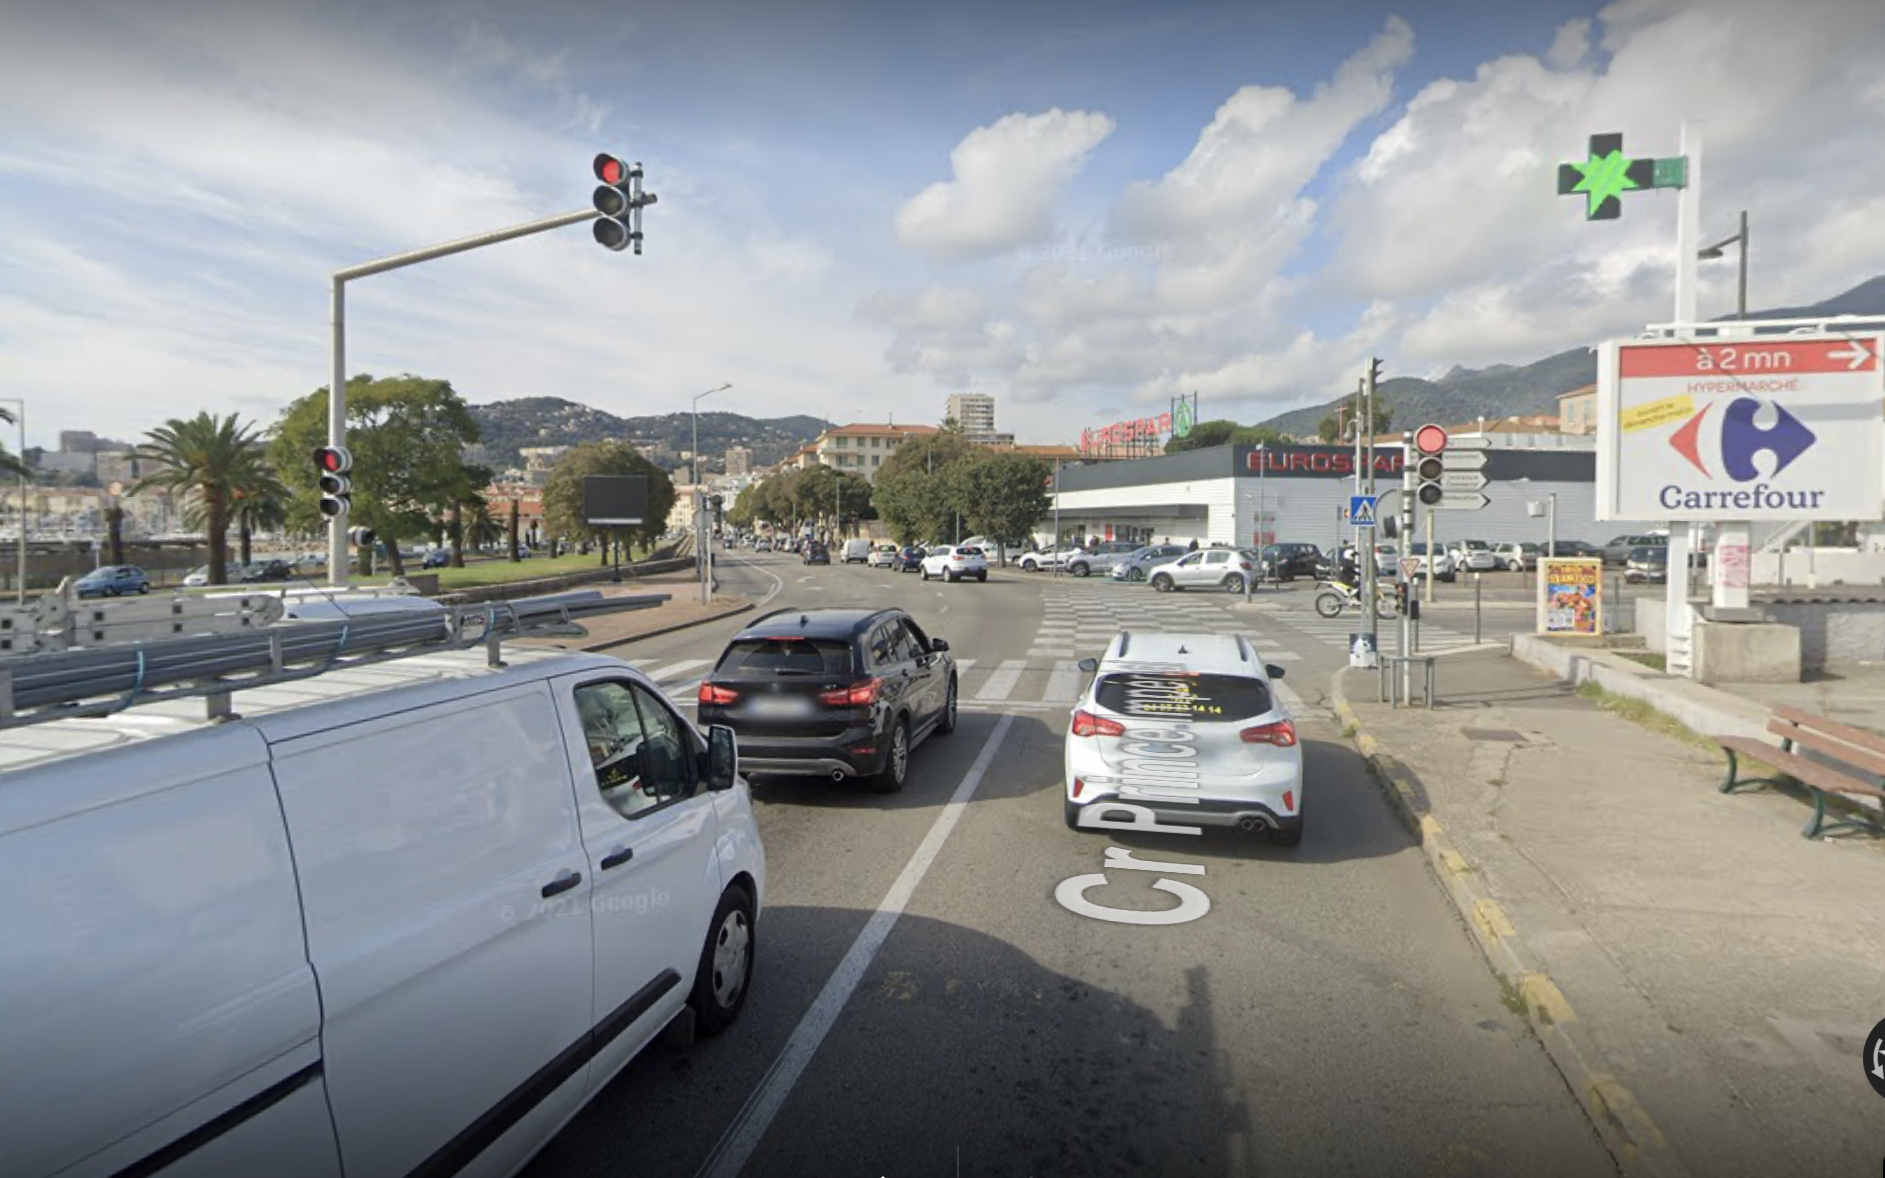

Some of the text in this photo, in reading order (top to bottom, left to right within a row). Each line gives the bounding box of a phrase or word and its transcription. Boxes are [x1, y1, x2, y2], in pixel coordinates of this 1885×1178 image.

[1695, 347, 1792, 370] à 2 mn
[1687, 378, 1799, 394] HYPERMARCHÉ
[1080, 412, 1171, 451] EUROSPAR
[1659, 484, 1825, 510] Carrefour
